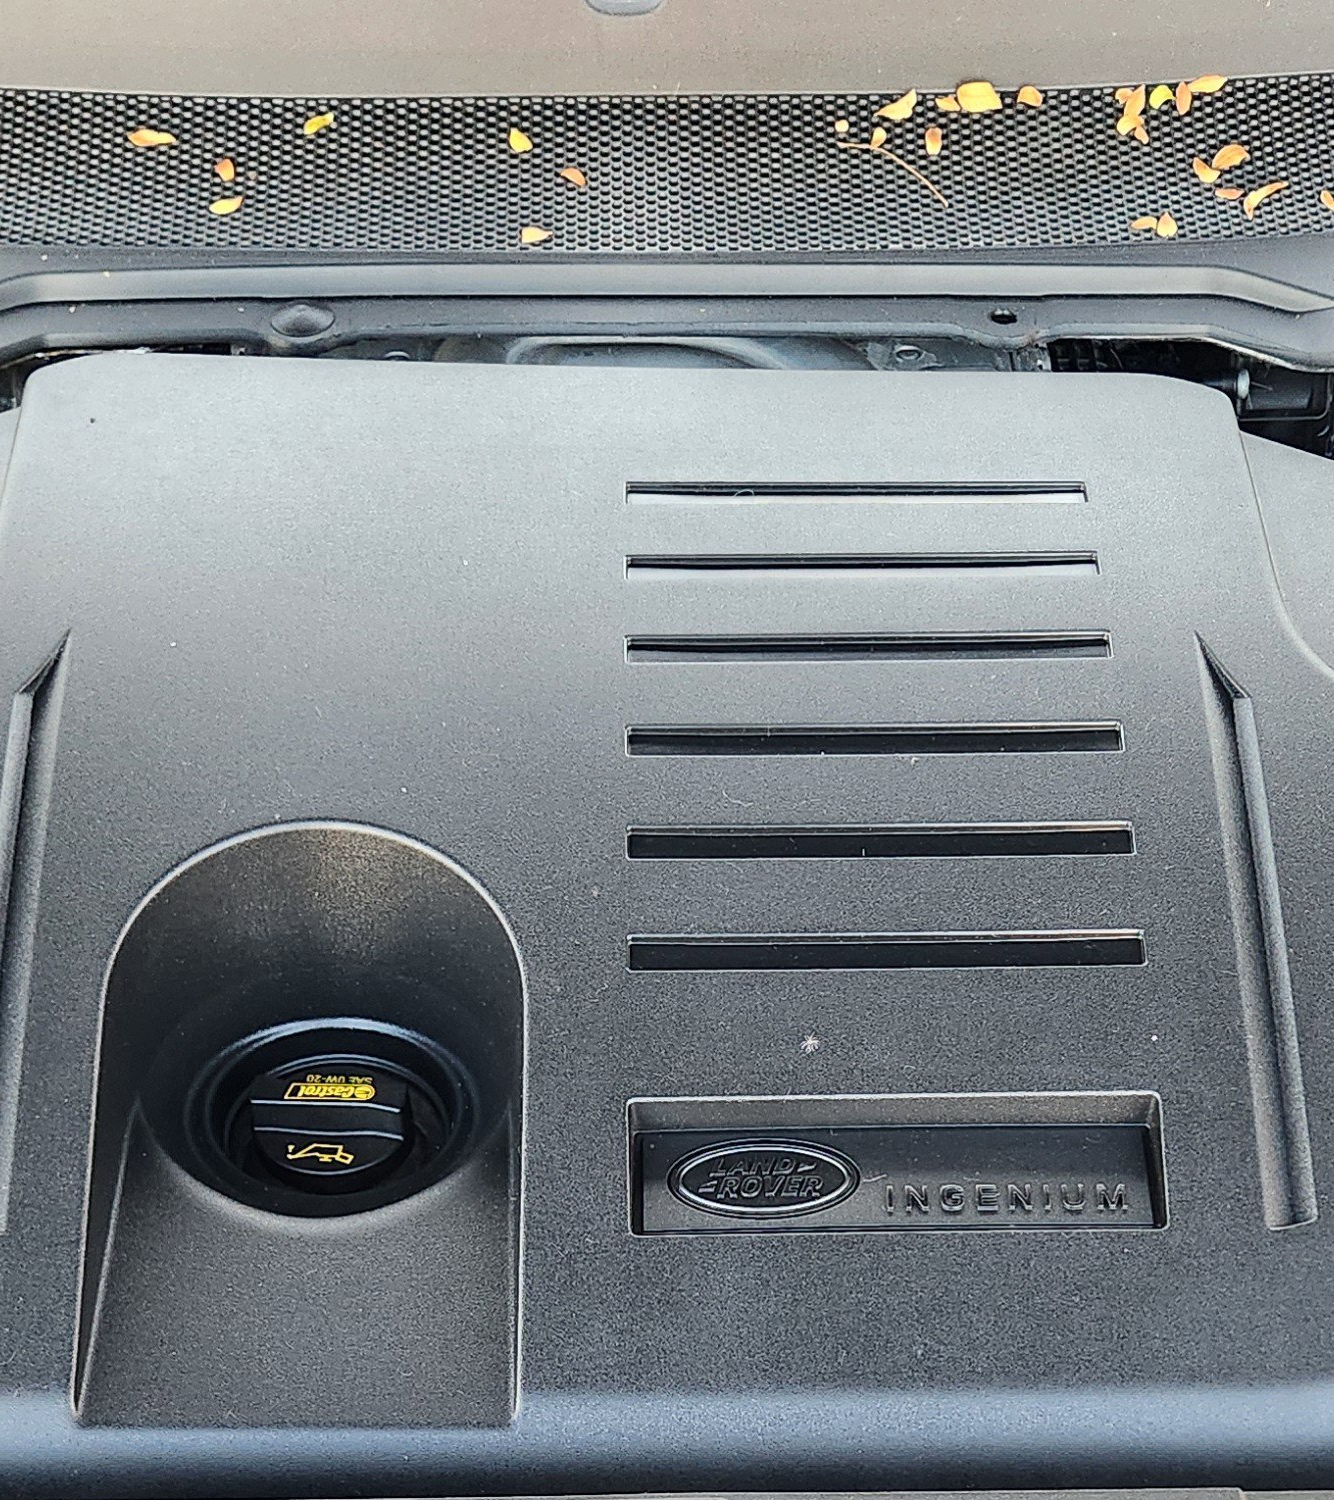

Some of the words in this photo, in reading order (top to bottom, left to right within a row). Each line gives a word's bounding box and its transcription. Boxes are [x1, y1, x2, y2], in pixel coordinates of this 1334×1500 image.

[297, 1084, 355, 1098] Castrol
[712, 1157, 798, 1177] LAND
[716, 1176, 823, 1199] ROVER
[883, 1182, 1130, 1214] INGENIUM
